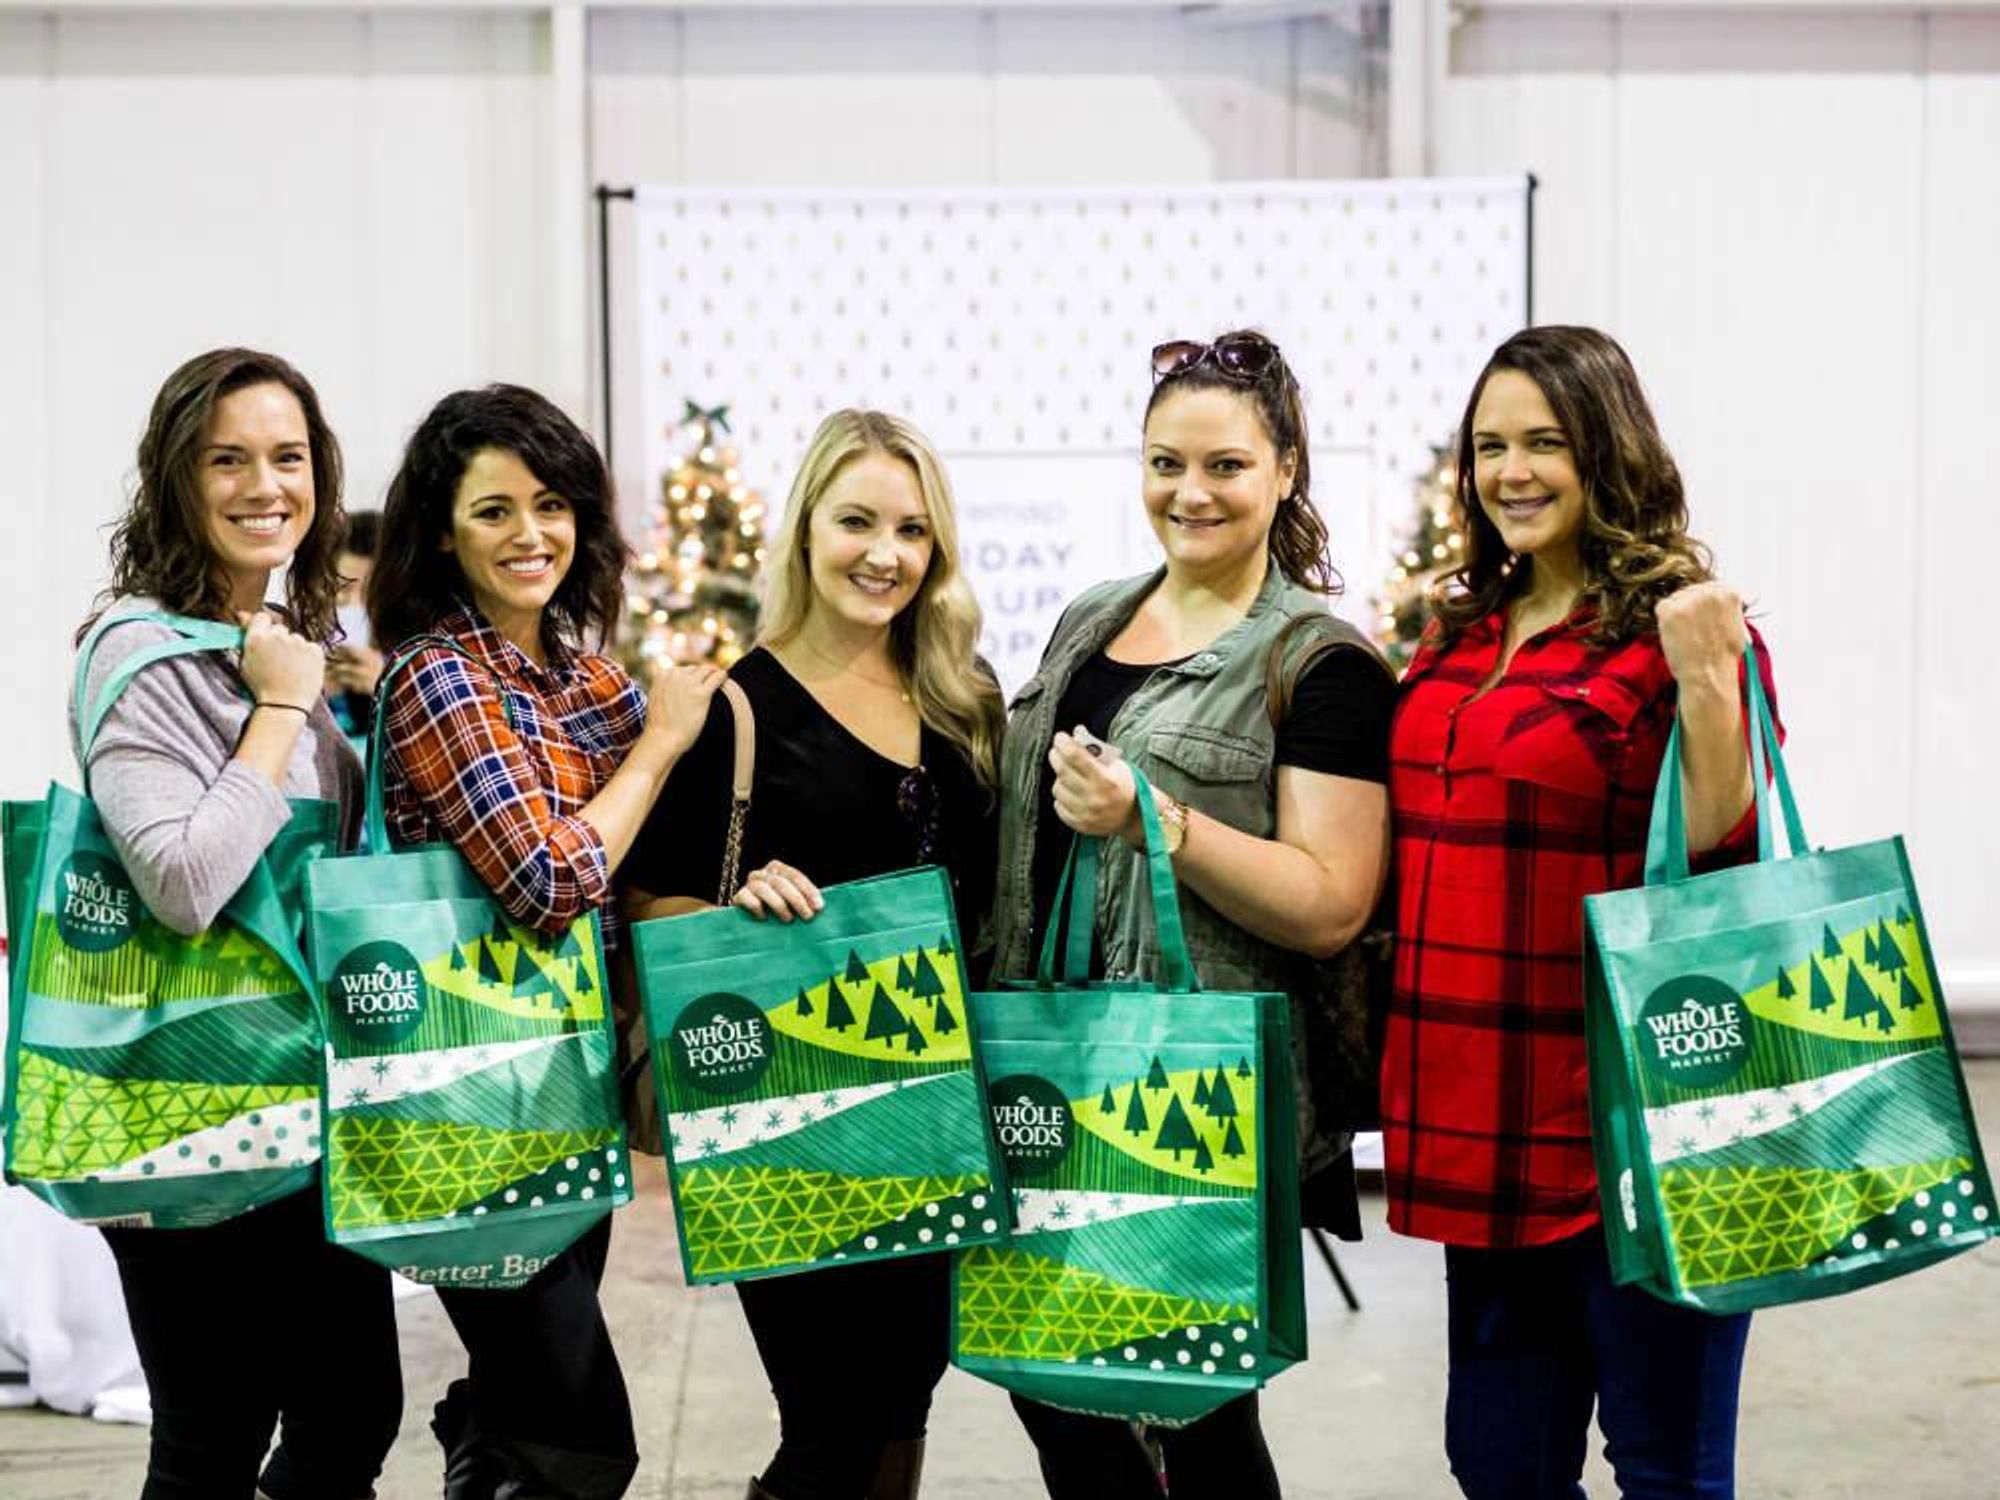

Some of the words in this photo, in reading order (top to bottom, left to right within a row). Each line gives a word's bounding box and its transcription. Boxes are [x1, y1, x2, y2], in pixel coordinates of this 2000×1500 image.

[64, 871, 130, 908] WHOLE
[64, 893, 129, 926] FOODS
[340, 967, 419, 993] WHOLE
[346, 990, 418, 1014] FOODS
[355, 1013, 410, 1026] MARKET
[1645, 1001, 1741, 1037] WHOLE
[678, 1017, 764, 1048] WHOLE
[1655, 1024, 1743, 1058] FOODS
[687, 1038, 764, 1068] FOODS
[1669, 1051, 1731, 1069] MARKET
[699, 1061, 754, 1077] MARKET
[998, 1126, 1062, 1146] OODS
[1006, 1148, 1051, 1158] ARKET
